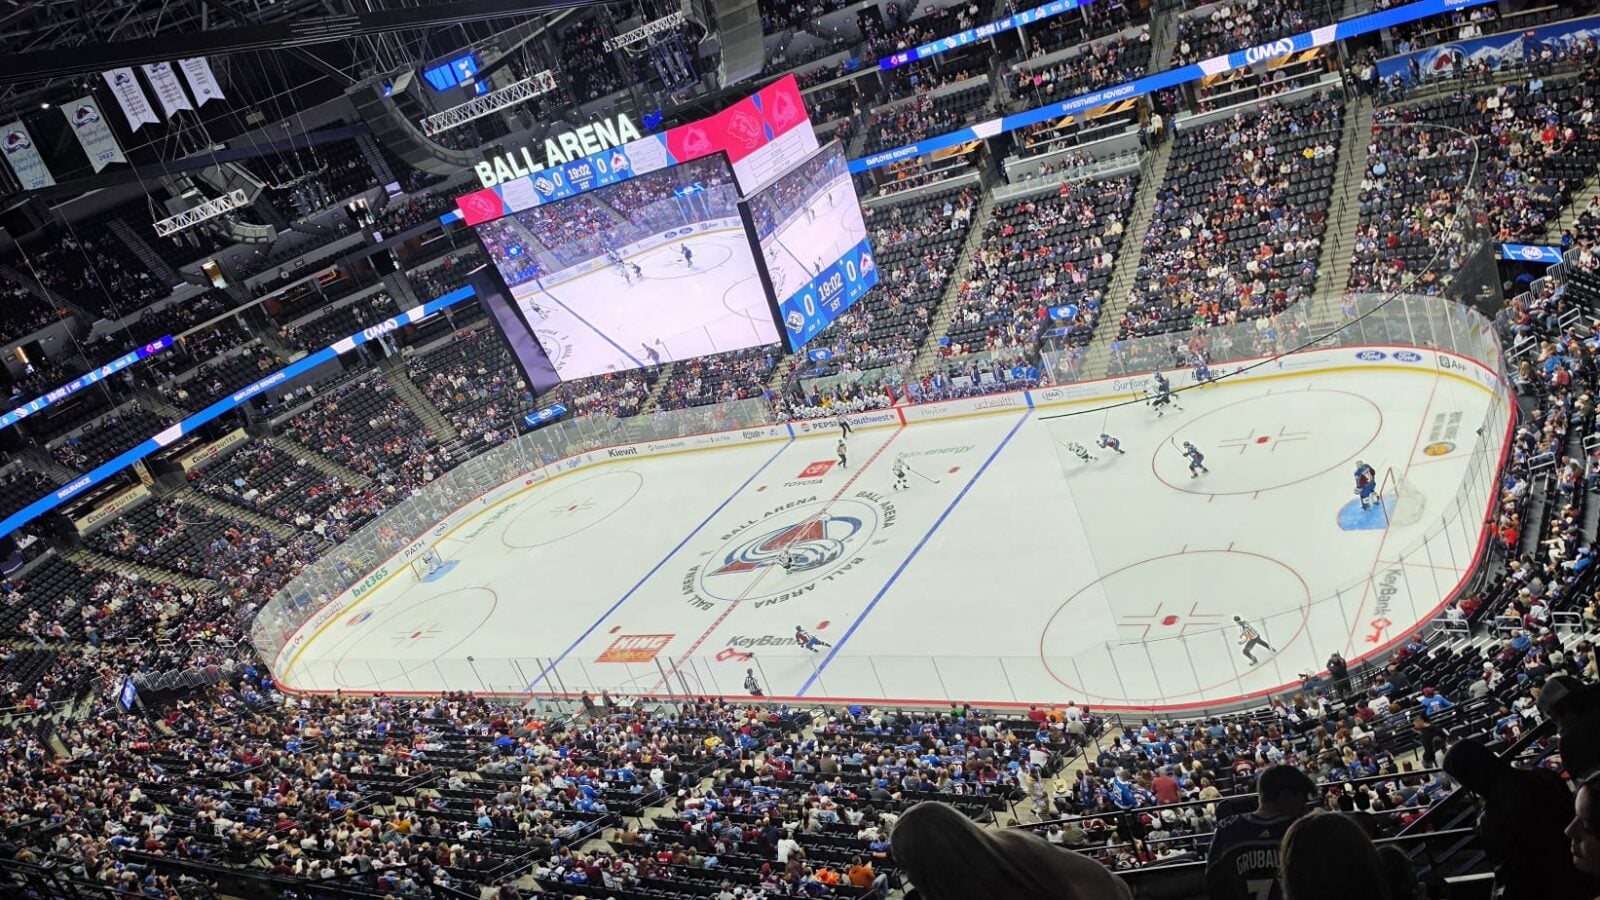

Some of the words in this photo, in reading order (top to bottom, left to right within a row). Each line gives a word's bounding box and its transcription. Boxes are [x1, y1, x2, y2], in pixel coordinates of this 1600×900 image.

[1062, 93, 1102, 111] INVESTMENT
[1102, 84, 1135, 101] ADVISORY
[474, 146, 544, 189] BALL
[545, 113, 642, 167] ARENA
[865, 151, 893, 166] EMPLOYEE
[892, 145, 918, 161] BENEFITS
[567, 163, 592, 181] 19:02
[596, 157, 608, 174] 0
[552, 171, 563, 188] 0
[846, 260, 857, 282] 0
[818, 271, 843, 301] 19:02
[803, 294, 815, 317] 0
[830, 297, 842, 312] 1ST
[812, 421, 838, 430] PEPSI
[849, 414, 890, 426] Southwest
[607, 446, 638, 458] Kiewit
[57, 476, 91, 498] INSURANCE
[783, 479, 823, 488] TOYOTA
[114, 491, 138, 508] SUITES
[854, 490, 885, 503] BALL
[880, 500, 897, 529] ARENA
[721, 519, 759, 541] BALL
[763, 495, 818, 518] ARENA
[404, 540, 427, 559] PATH
[823, 556, 865, 582] BALL
[352, 567, 389, 598] bet365
[682, 564, 701, 596] ARENA
[754, 582, 816, 609] ARENA
[1373, 569, 1402, 616] KeyBank
[687, 596, 715, 611] BALL
[726, 635, 800, 648] KeyBan
